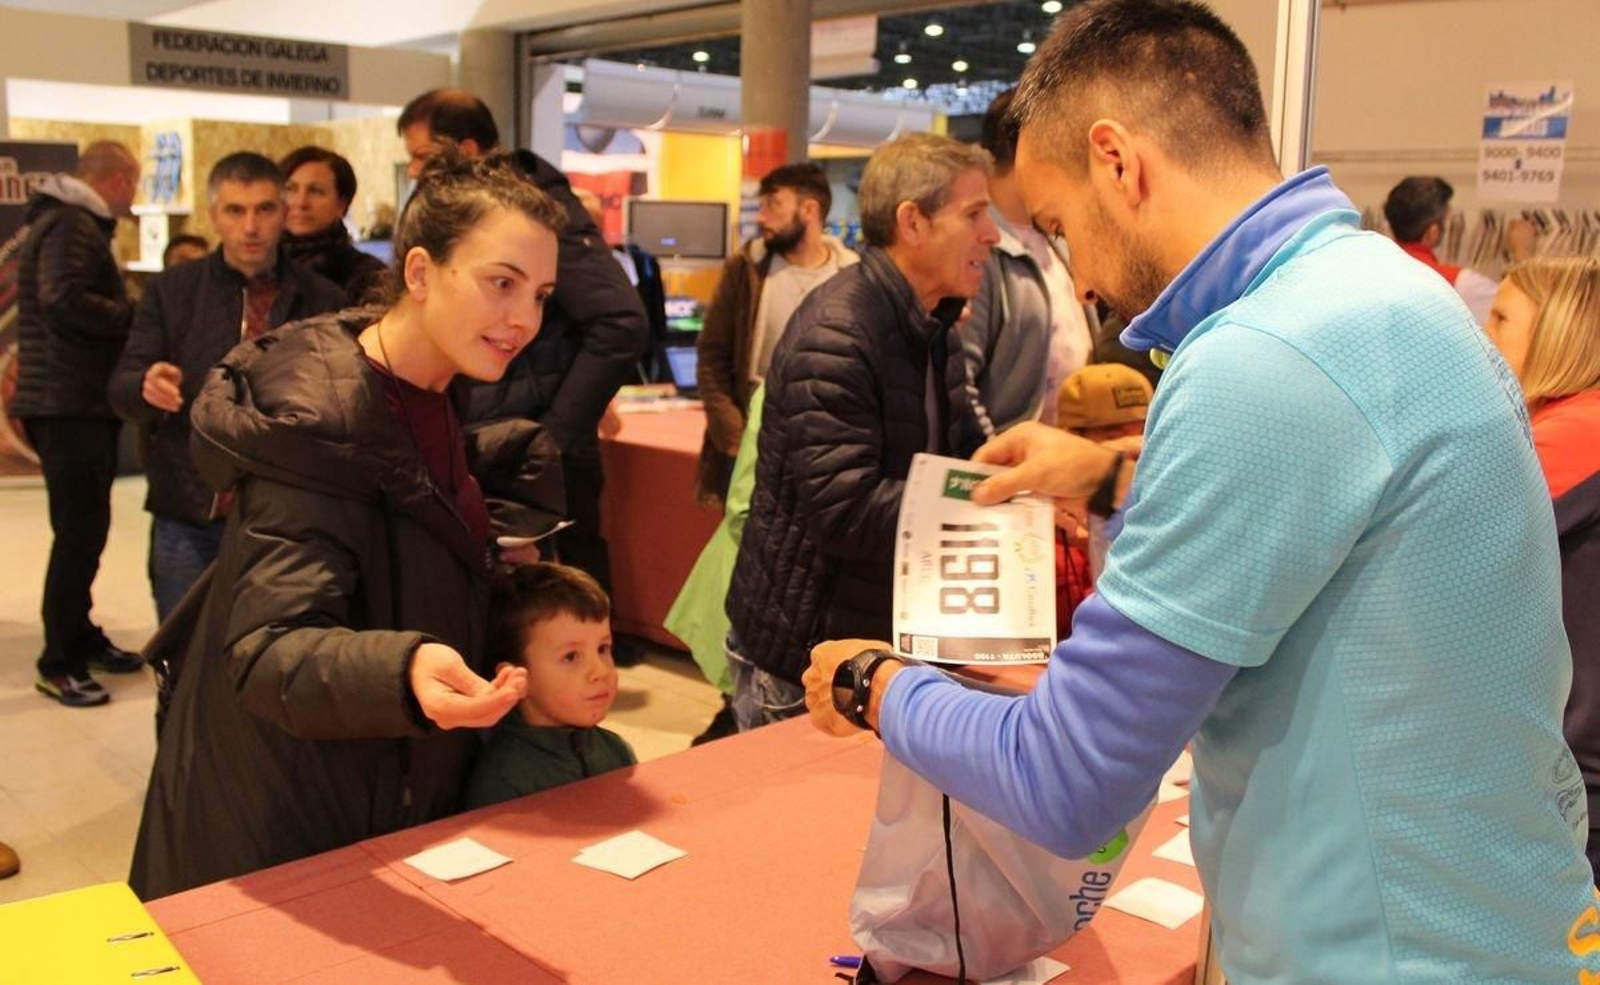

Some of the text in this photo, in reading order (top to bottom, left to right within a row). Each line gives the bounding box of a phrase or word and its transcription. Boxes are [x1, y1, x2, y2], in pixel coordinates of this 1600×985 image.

[264, 43, 328, 62] GALEGA
[145, 62, 340, 93] DEPORTES DE INVIERNO
[940, 523, 1000, 614] 1198
